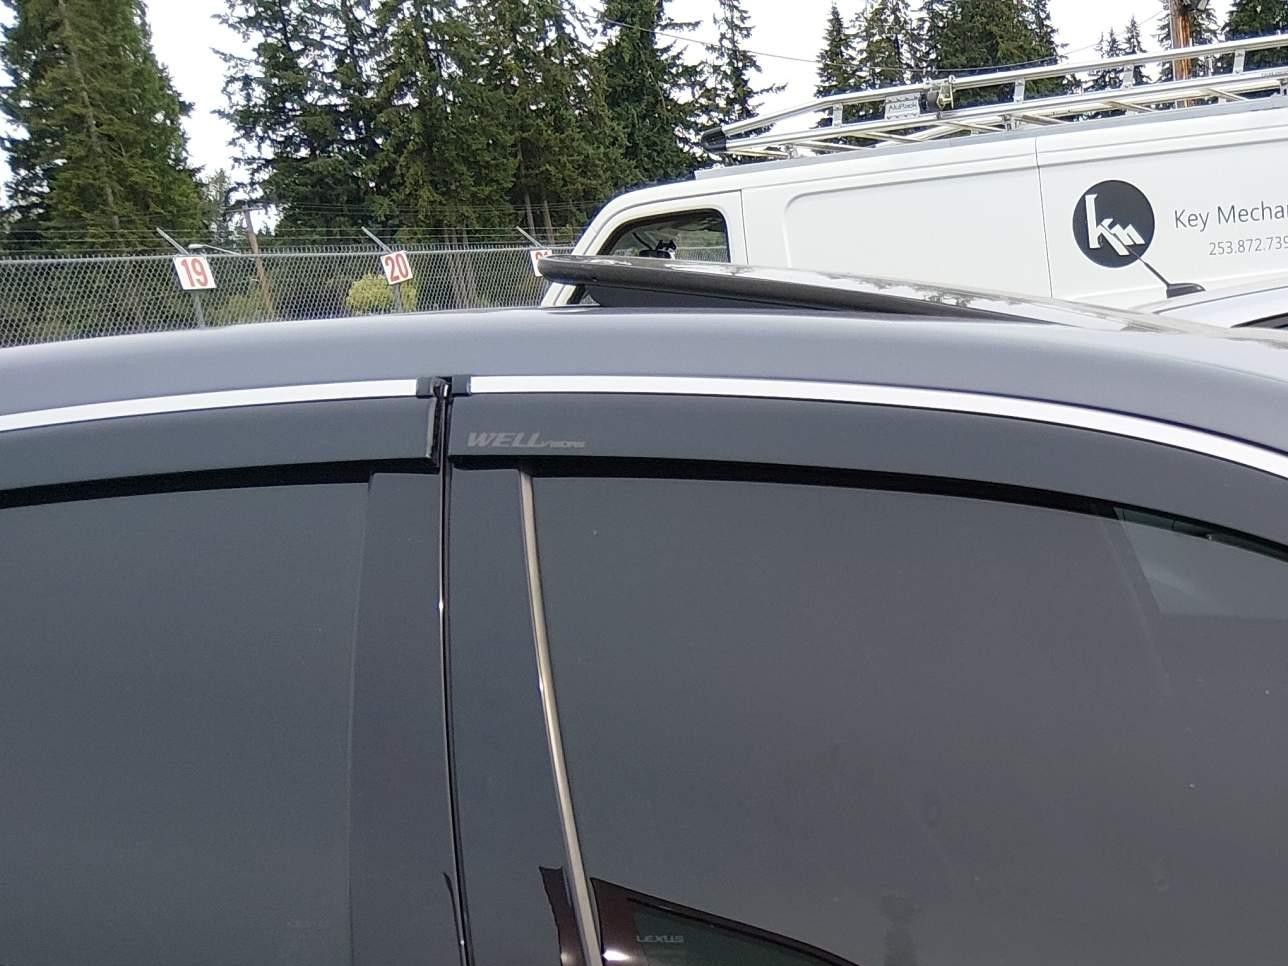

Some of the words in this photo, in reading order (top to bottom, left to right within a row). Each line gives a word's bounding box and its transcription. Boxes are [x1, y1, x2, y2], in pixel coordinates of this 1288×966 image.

[1174, 209, 1210, 232] Key
[181, 258, 208, 287] 19
[384, 253, 409, 282] 20
